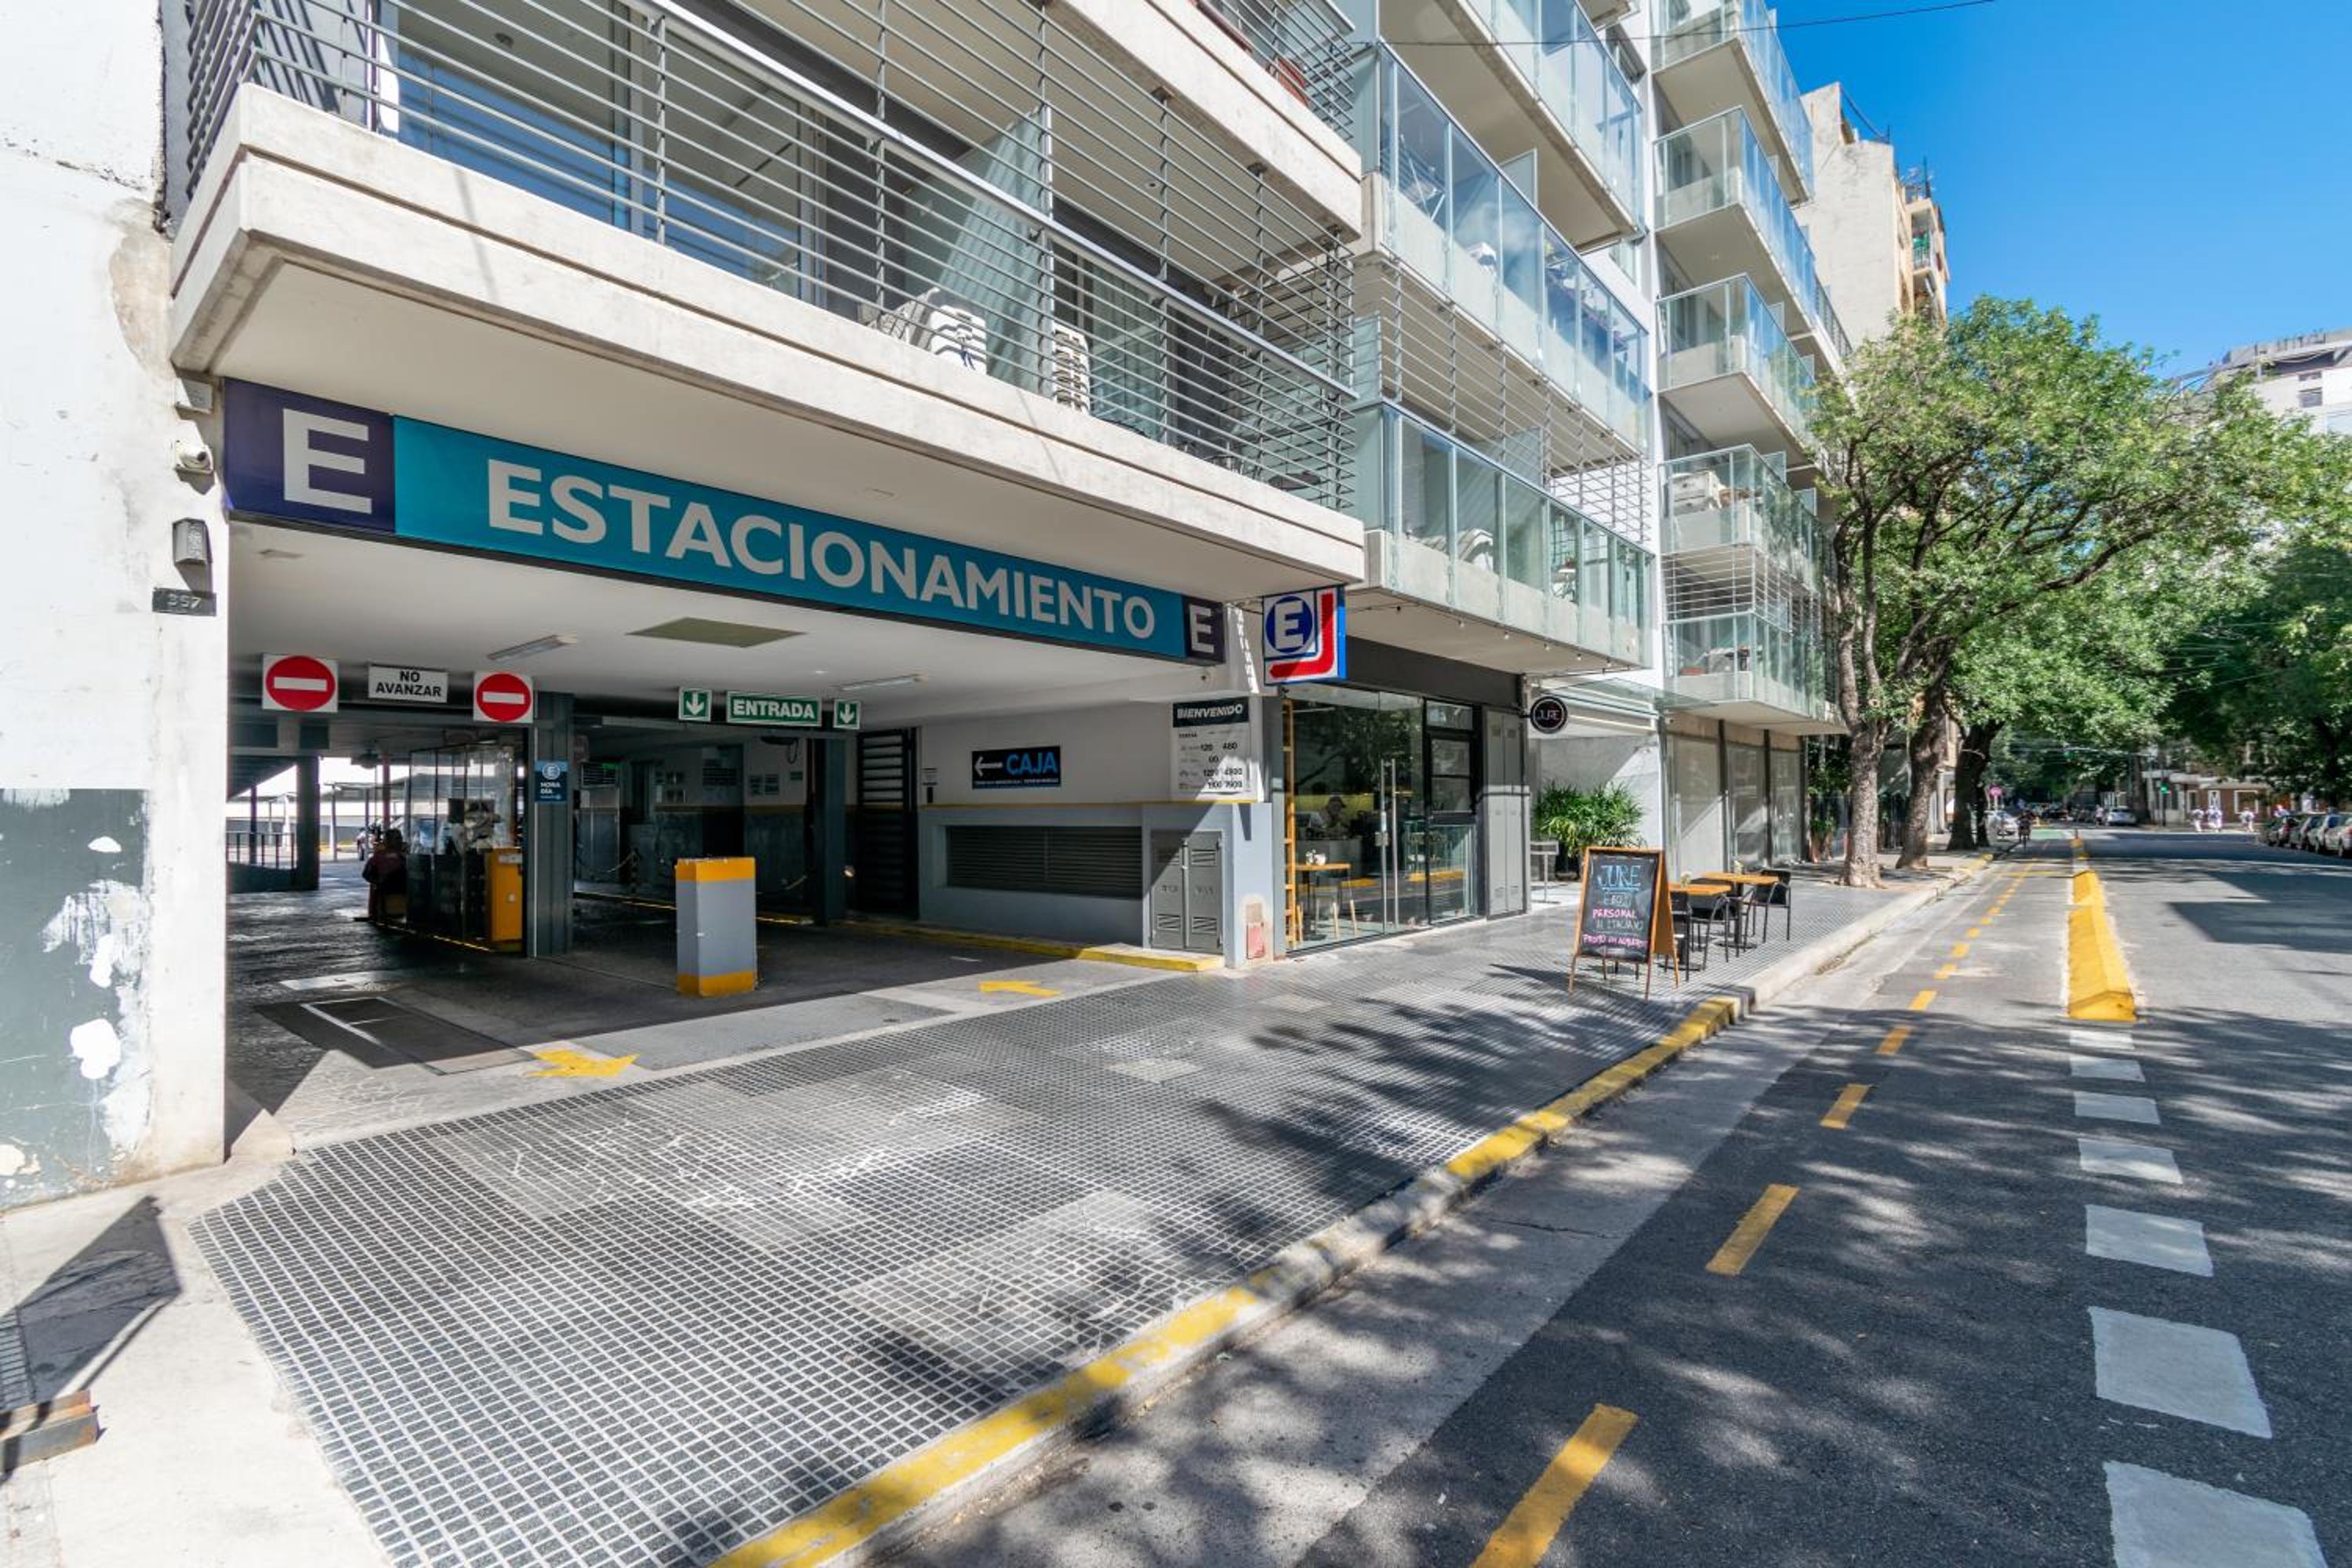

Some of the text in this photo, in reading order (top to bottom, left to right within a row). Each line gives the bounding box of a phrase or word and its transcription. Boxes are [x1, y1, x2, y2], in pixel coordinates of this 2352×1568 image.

[283, 408, 372, 514] E
[488, 459, 1155, 639] ESTACIONAMIENTO
[1189, 604, 1214, 653] E
[1275, 600, 1303, 649] E
[400, 670, 420, 682] NO
[376, 682, 441, 696] AVANZAR
[733, 699, 815, 719] ENTRADA
[1177, 703, 1243, 719] BIENVENIDO
[1006, 752, 1058, 775] CAJA
[1597, 865, 1642, 887] JURE
